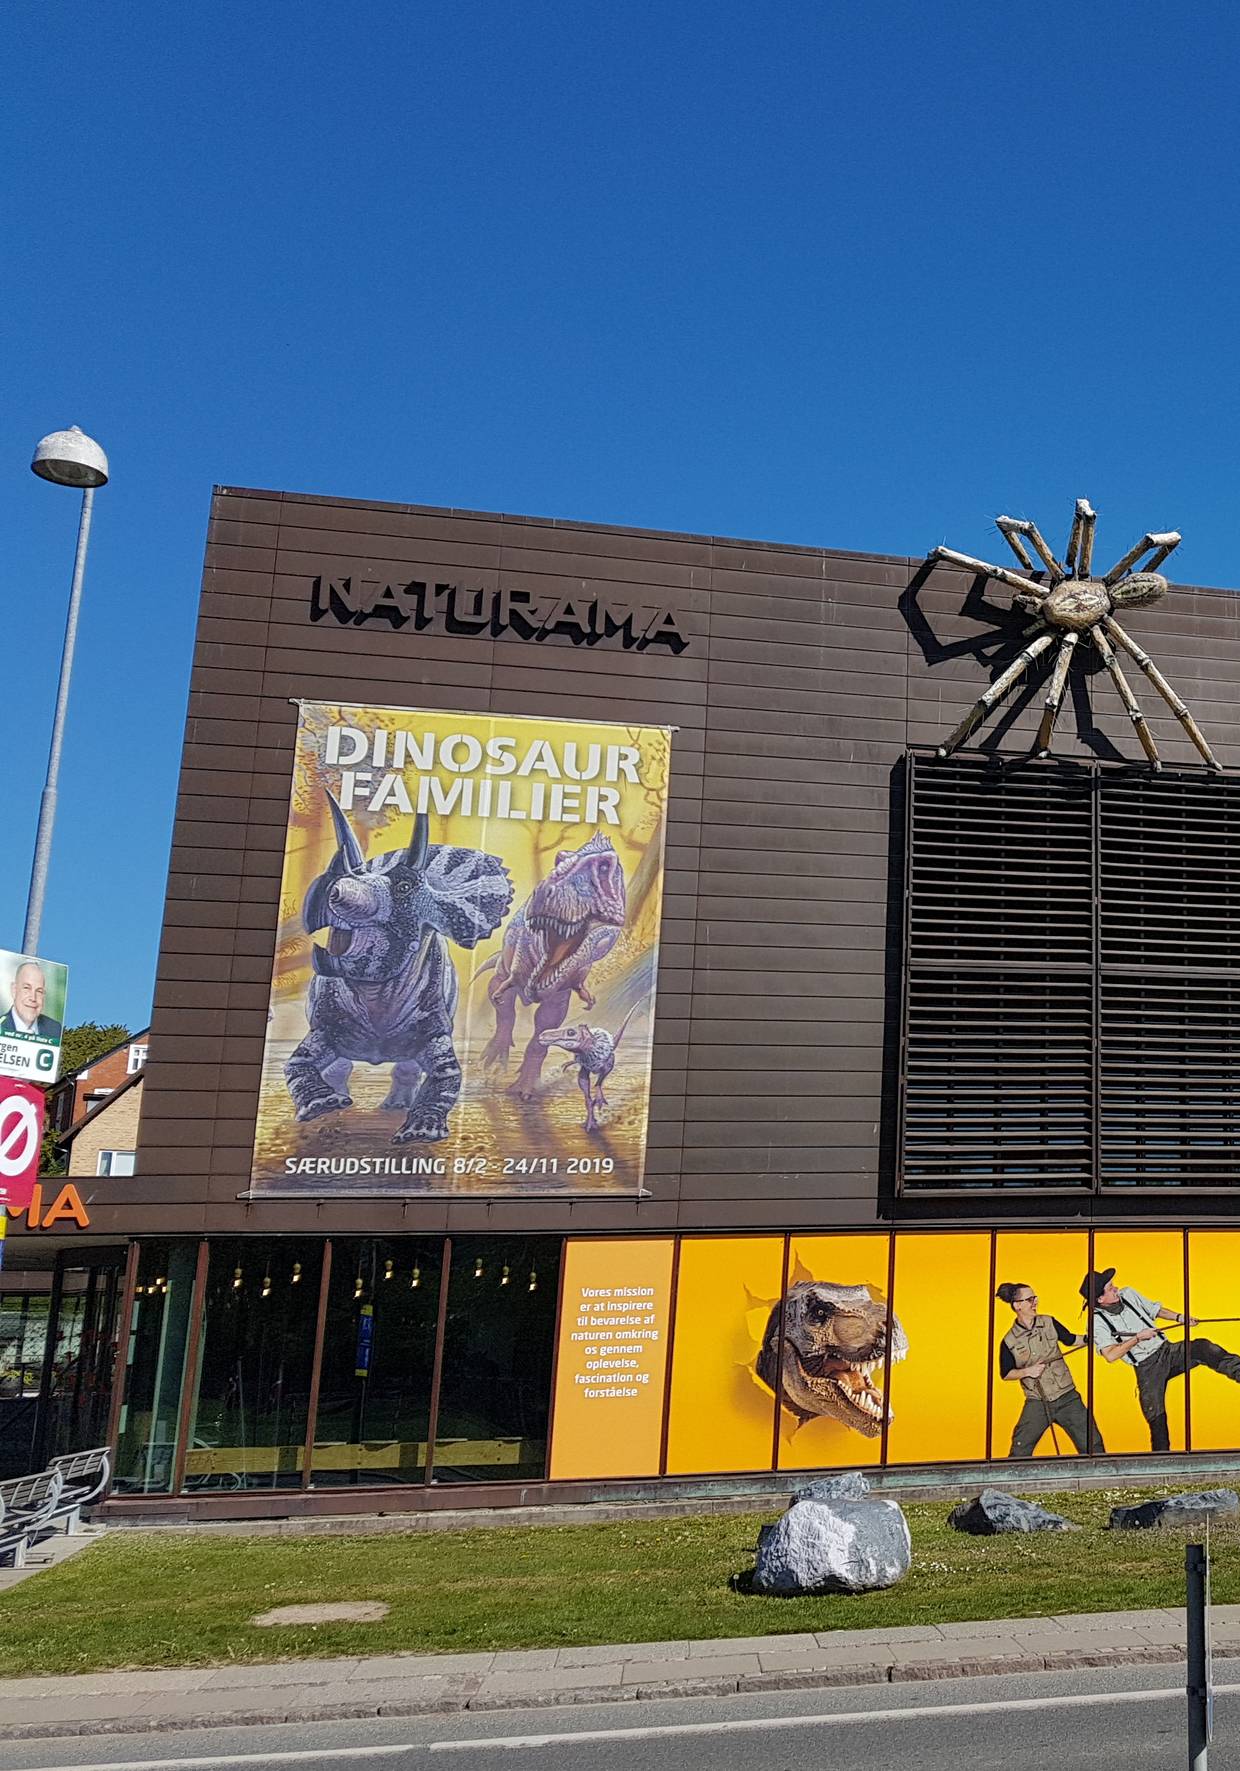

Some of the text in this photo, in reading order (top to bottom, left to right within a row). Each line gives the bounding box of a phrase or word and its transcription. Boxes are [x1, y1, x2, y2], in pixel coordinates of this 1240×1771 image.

[311, 575, 690, 653] NATURAMA
[325, 725, 641, 784] DINOSAUR
[340, 771, 621, 825] FAMILIER
[0, 1043, 18, 1053] gen
[40, 1053, 51, 1067] C
[284, 1157, 446, 1175] SÆRUDSTILLING
[453, 1157, 487, 1174] 8/2
[502, 1157, 558, 1174] 24/11
[566, 1157, 614, 1174] 2019
[581, 1286, 654, 1297] Vores mission
[580, 1301, 653, 1313] er at inspirere
[577, 1314, 655, 1326] til bevarelse af
[571, 1329, 659, 1341] naturen omkring
[585, 1344, 643, 1357] os gennem
[586, 1359, 640, 1371] oplevelse,
[575, 1372, 649, 1384] fascination og
[584, 1387, 638, 1398] forståelse
